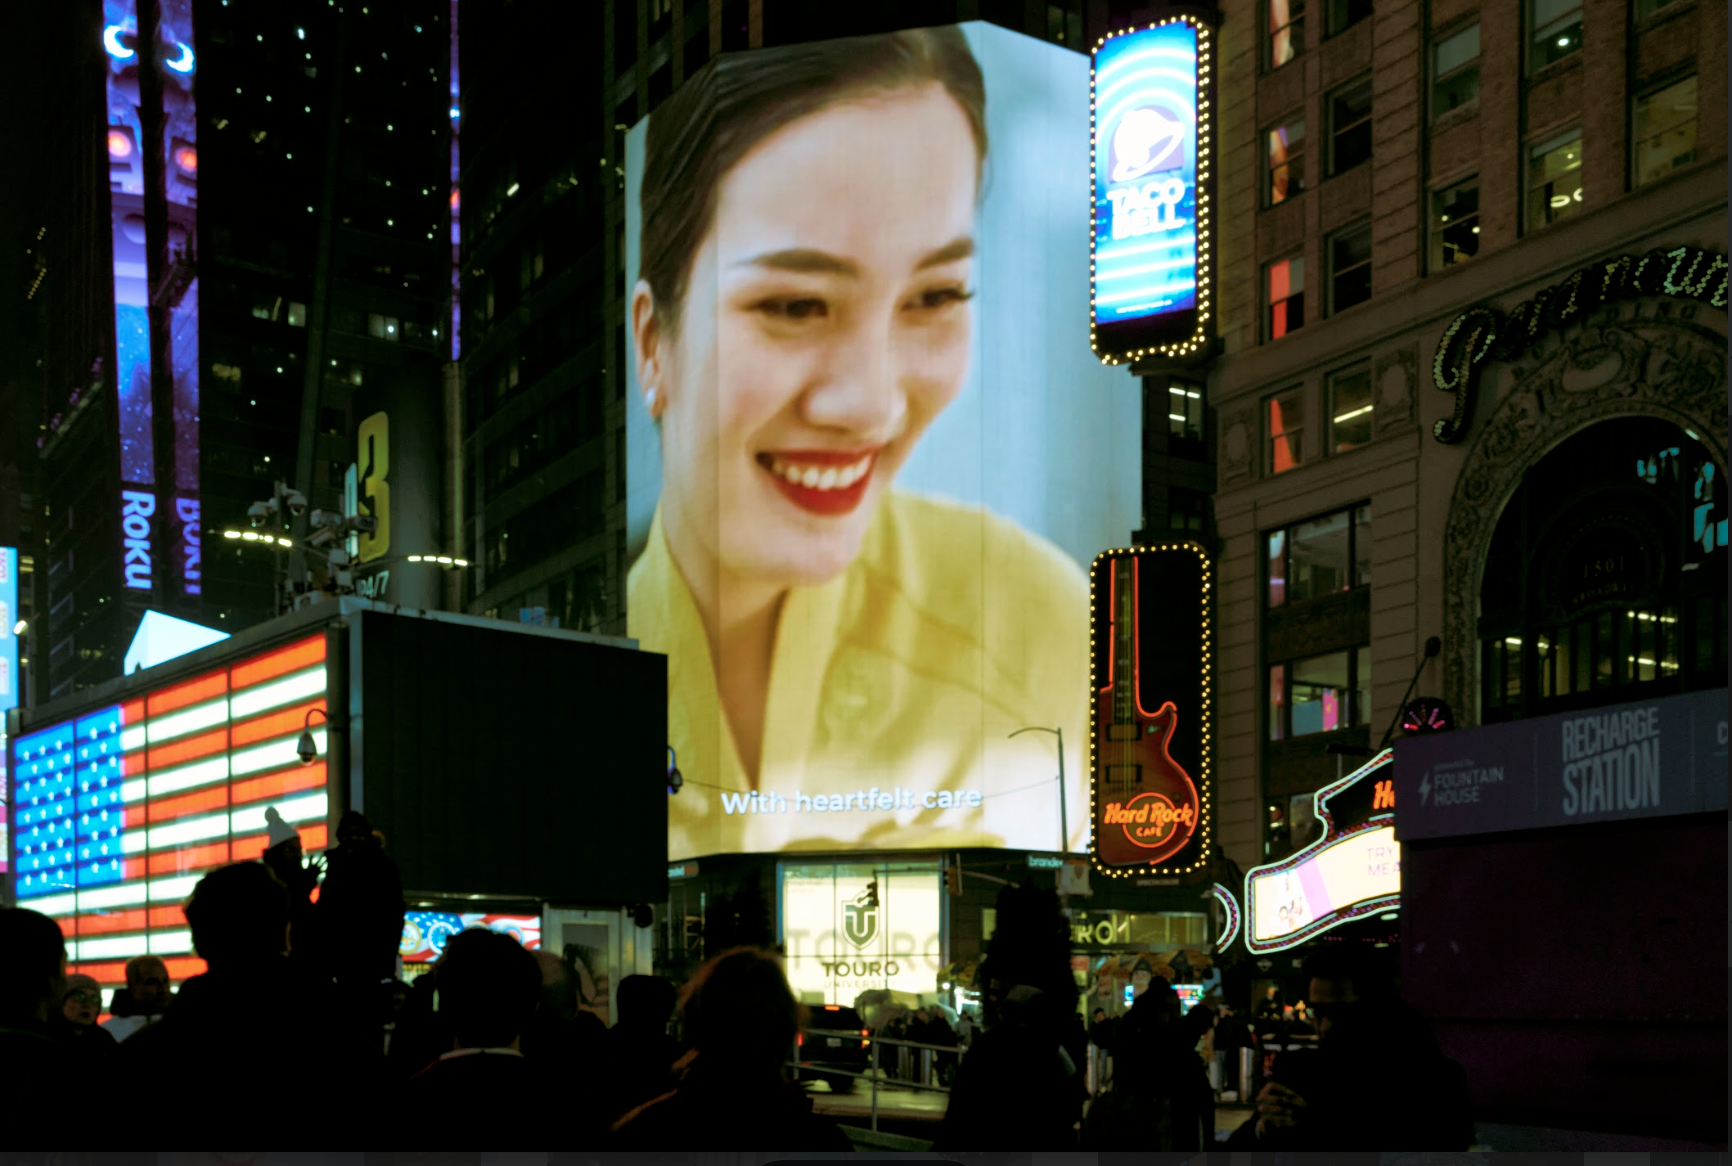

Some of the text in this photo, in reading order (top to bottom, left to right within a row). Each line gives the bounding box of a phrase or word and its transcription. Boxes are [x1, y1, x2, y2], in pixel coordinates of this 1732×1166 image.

[1106, 178, 1185, 215] TACO
[1112, 203, 1187, 240] BELL
[1562, 707, 1660, 763] RECHARGE
[1434, 766, 1505, 790] FOUNTAIN
[1562, 737, 1660, 815] STATION
[721, 787, 983, 814] With heartfelt care
[1434, 786, 1480, 807] HOUSE
[1104, 801, 1194, 827] Hard Rock
[1135, 826, 1163, 837] CAFE
[1367, 846, 1394, 860] TRY
[821, 960, 899, 978] TOURO
[824, 979, 896, 989] UNIVERSITY
